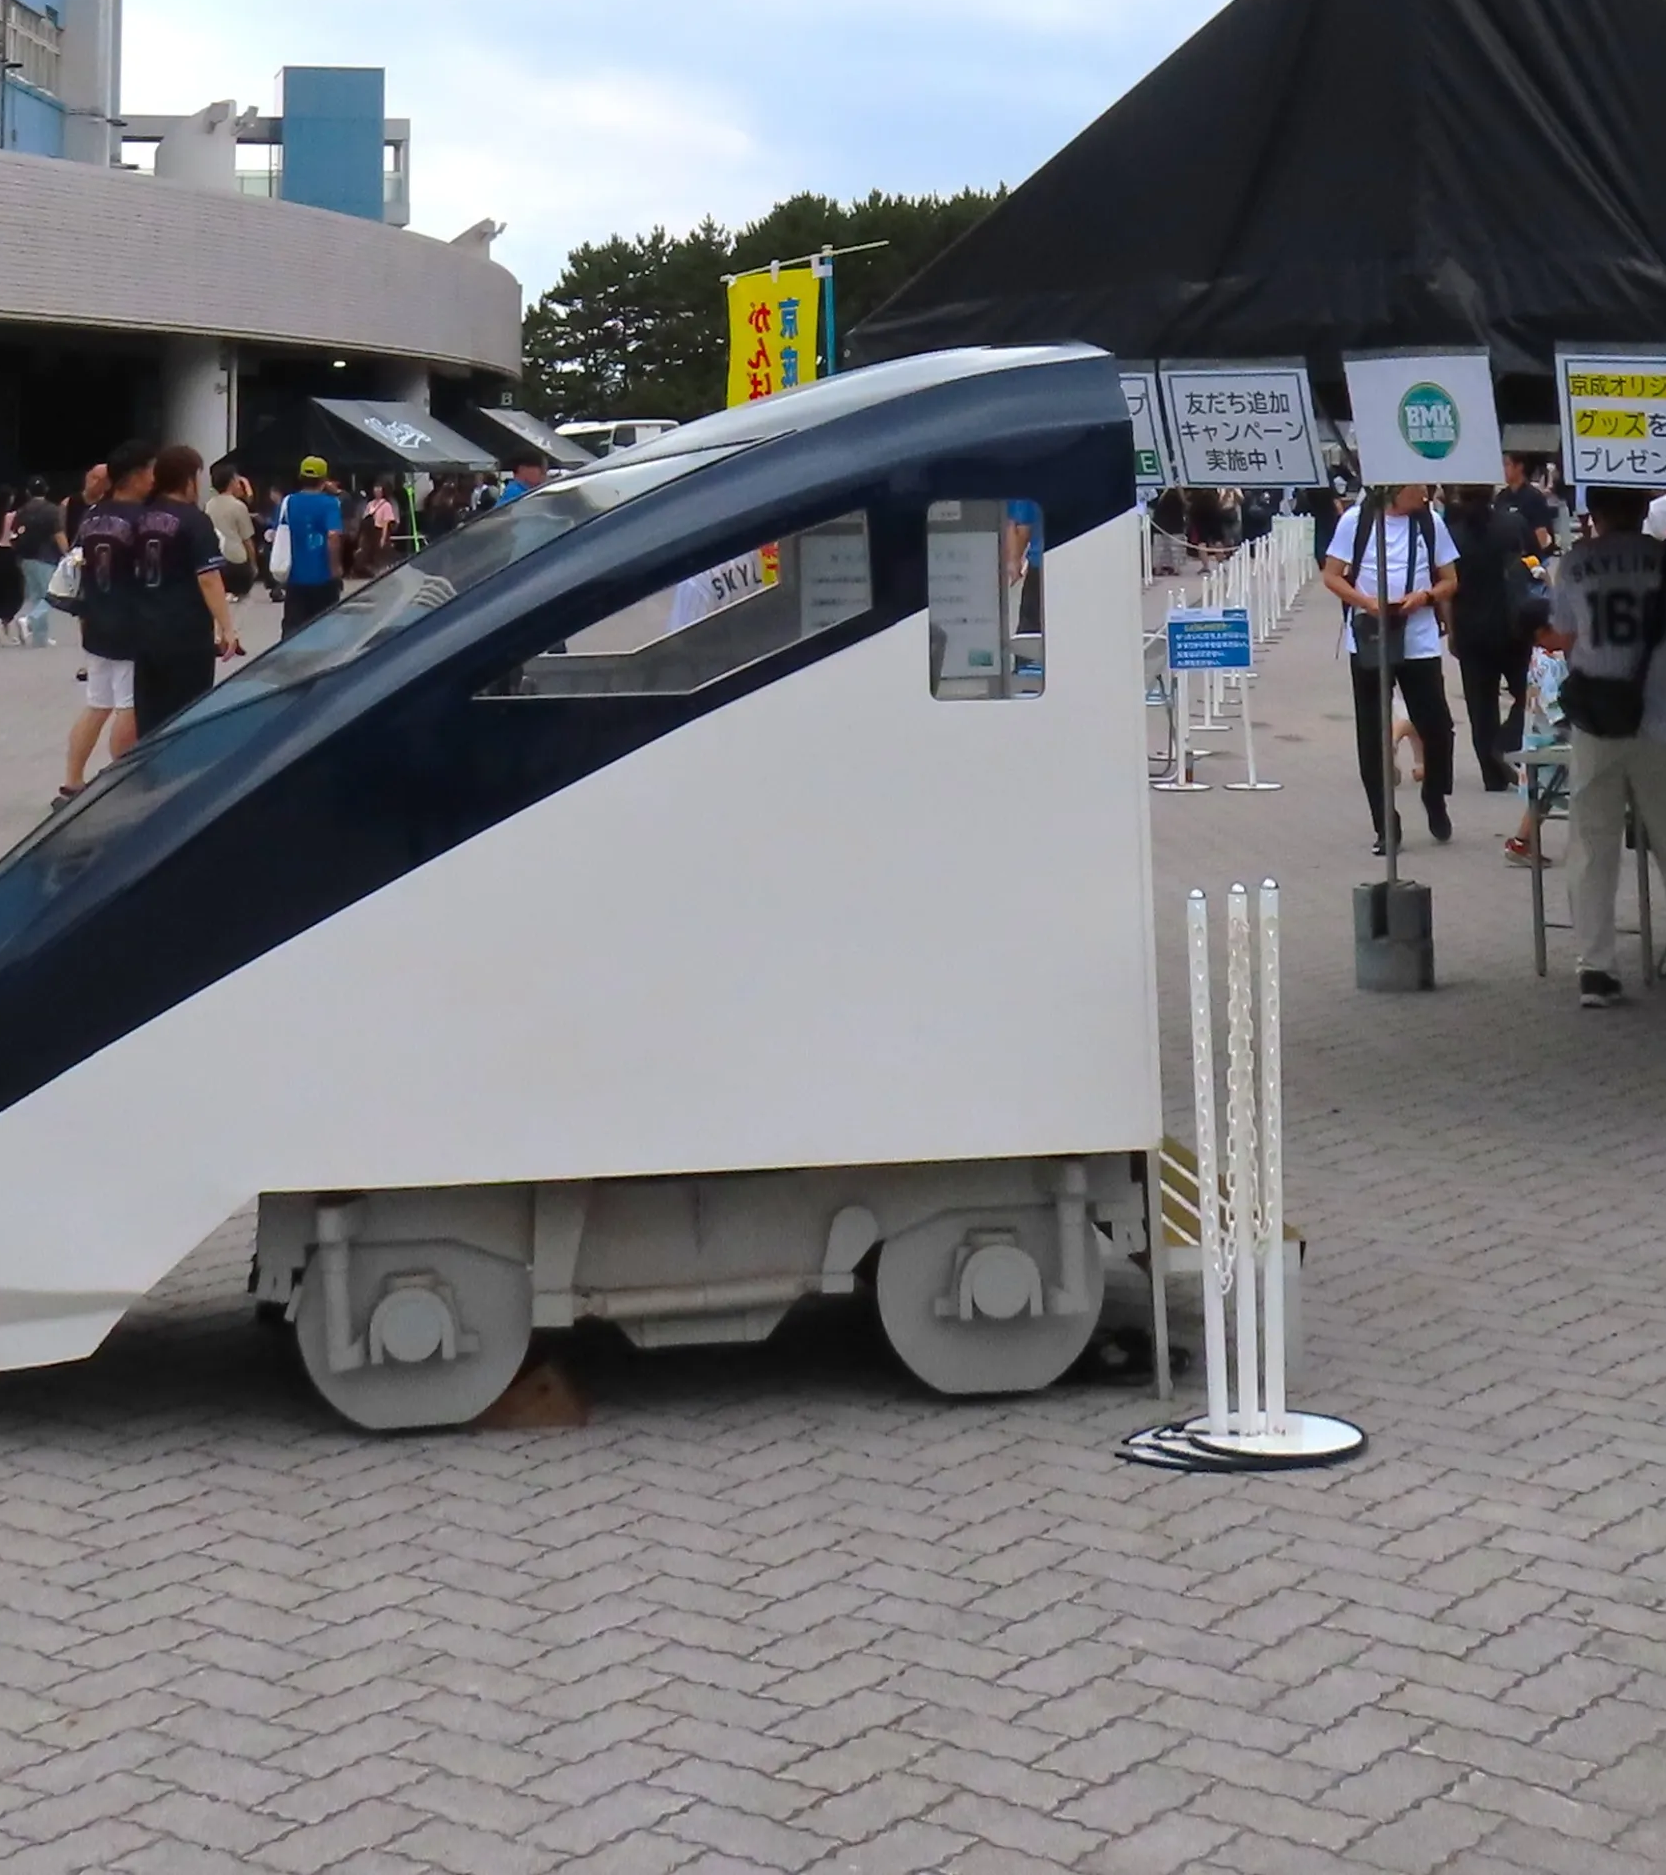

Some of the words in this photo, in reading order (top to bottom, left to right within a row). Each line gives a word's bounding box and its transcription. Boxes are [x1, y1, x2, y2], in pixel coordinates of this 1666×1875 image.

[1185, 390, 1290, 416] 友だち追加
[1181, 421, 1304, 442] キャンペーン
